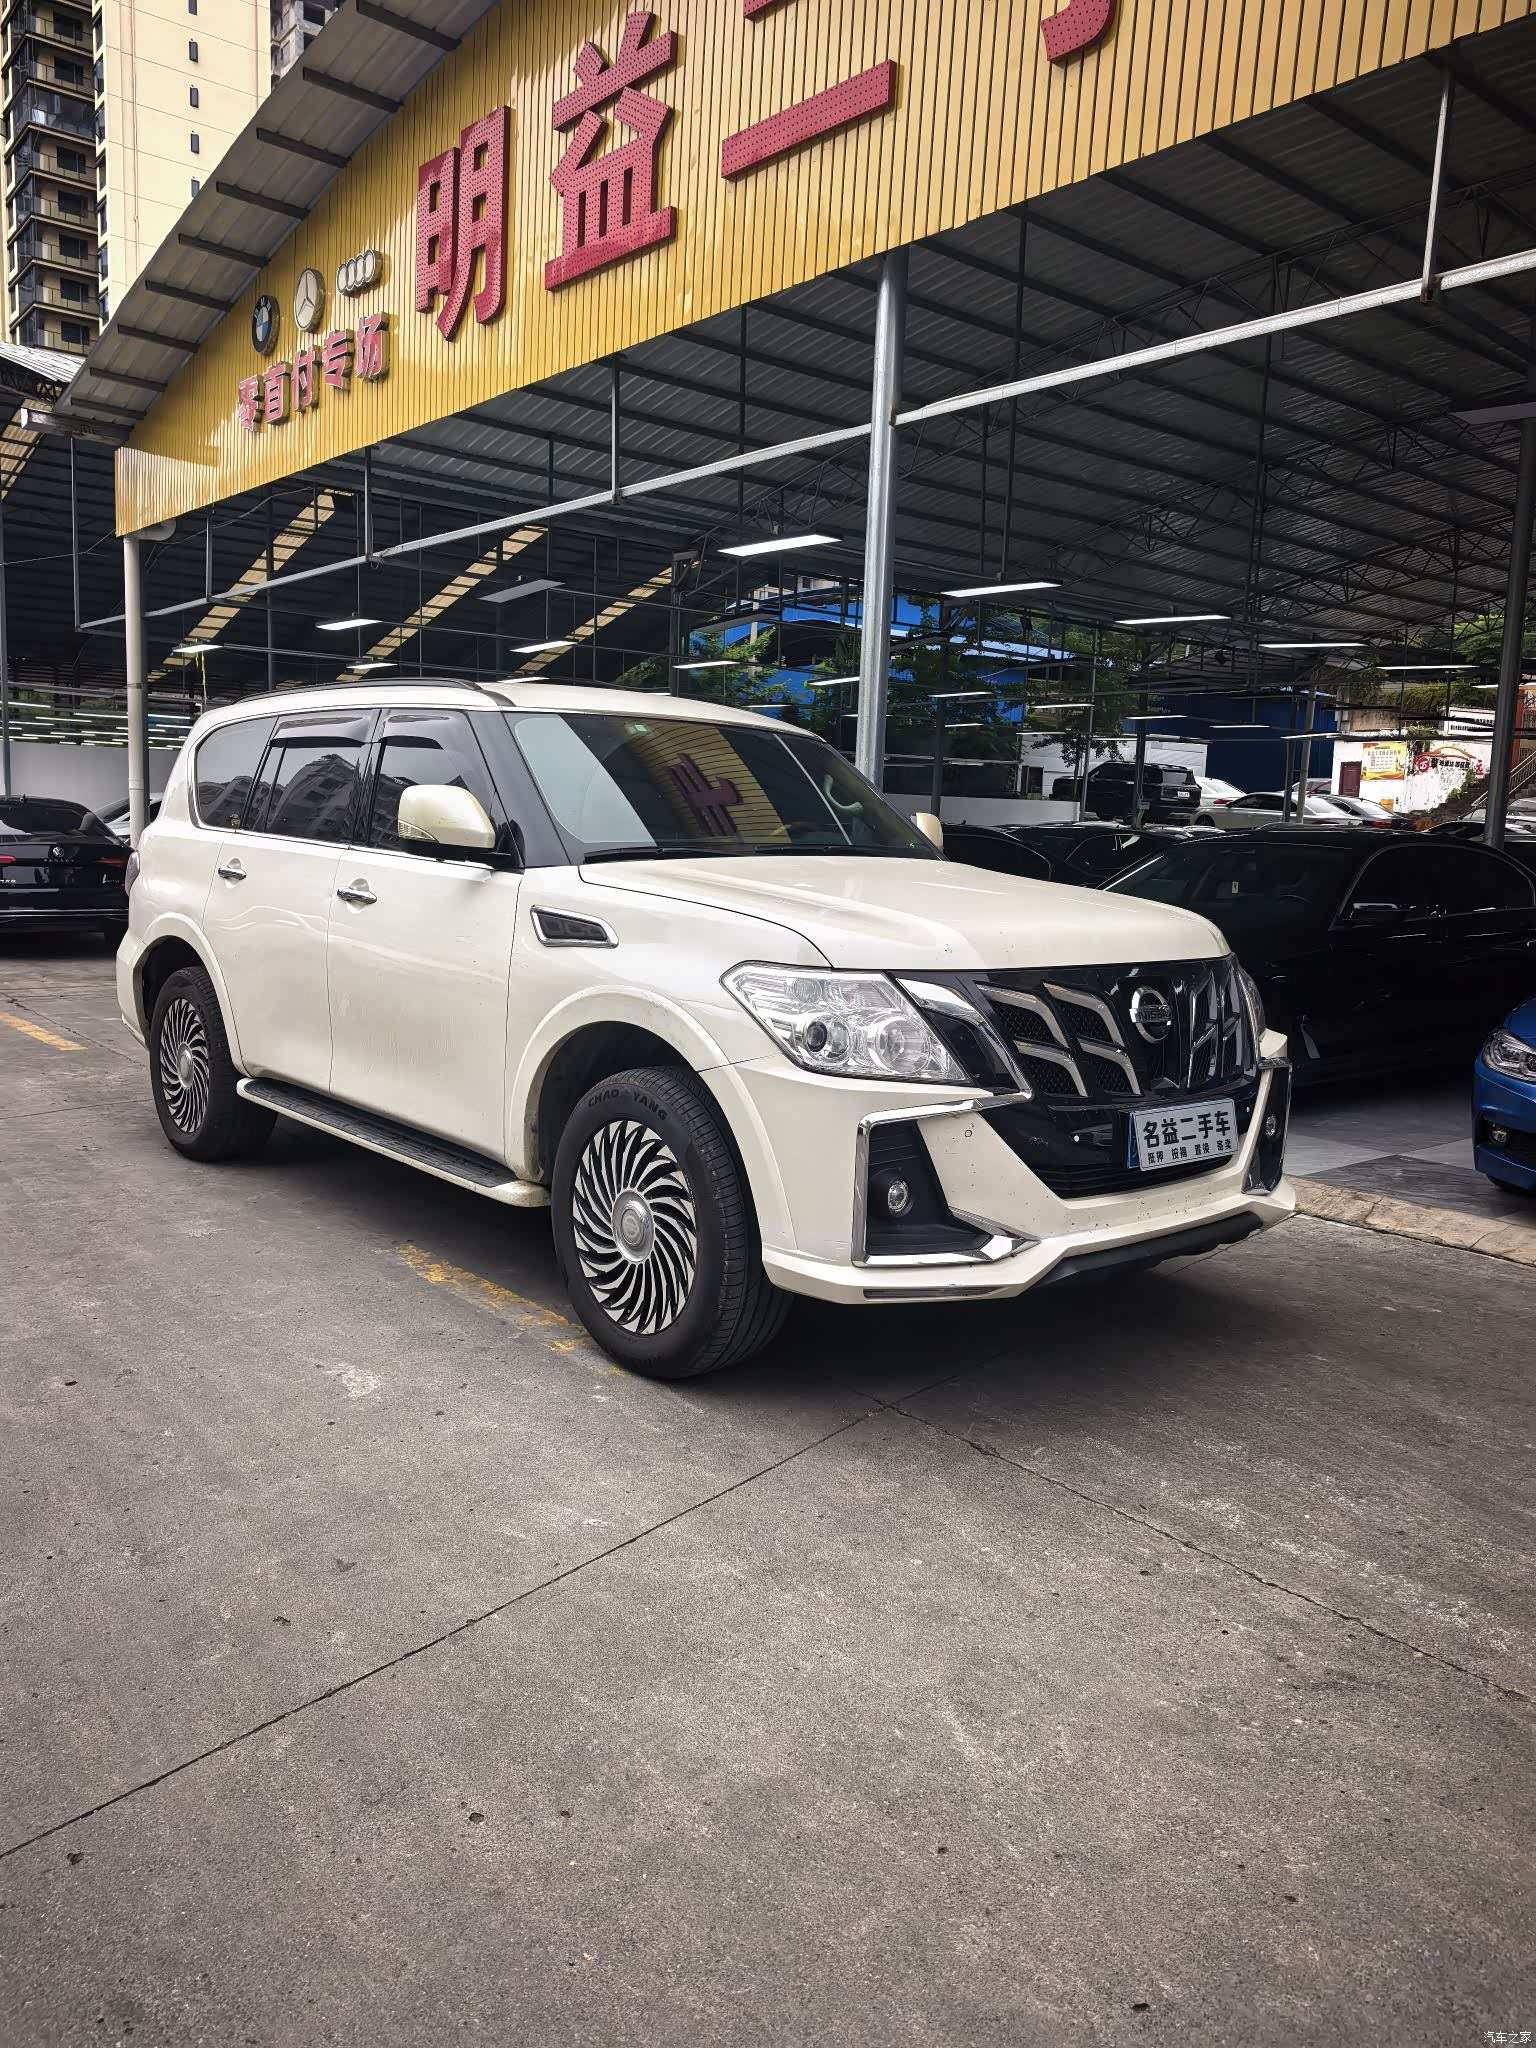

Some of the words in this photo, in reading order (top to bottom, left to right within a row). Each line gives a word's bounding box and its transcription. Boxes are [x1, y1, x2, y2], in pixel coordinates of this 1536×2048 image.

[238, 312, 389, 433] 零首付专场
[587, 1088, 620, 1108] CHAO
[633, 1090, 668, 1121] YANG
[1142, 1110, 1231, 1149] 名益二手车
